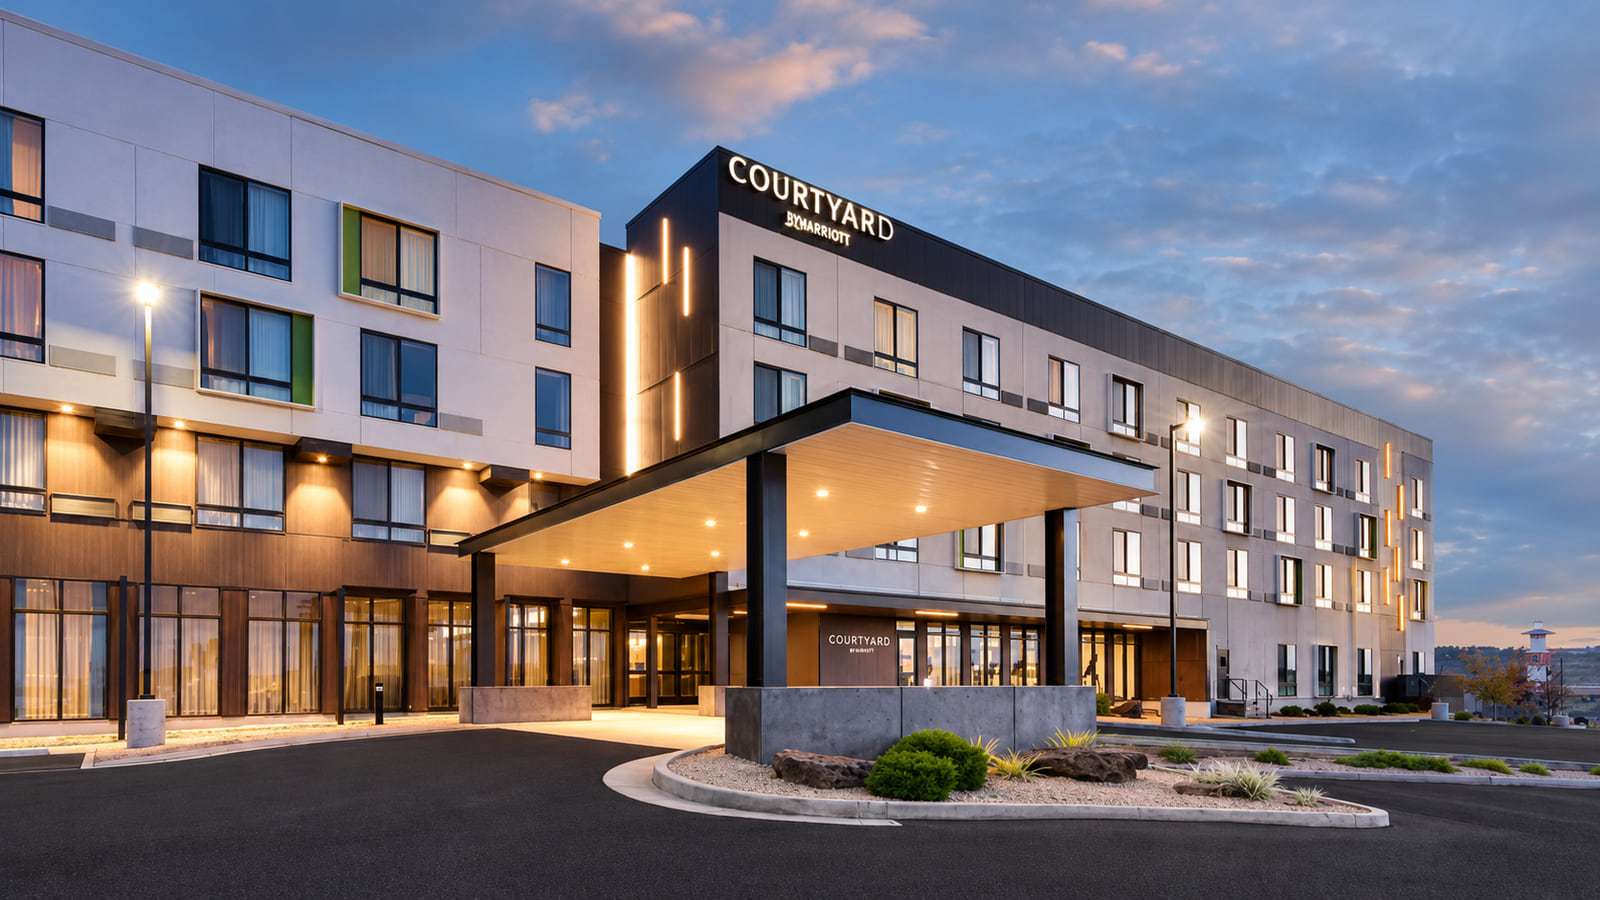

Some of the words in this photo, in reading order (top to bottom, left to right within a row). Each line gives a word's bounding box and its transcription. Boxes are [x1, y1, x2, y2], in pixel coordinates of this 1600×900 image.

[728, 156, 894, 241] COURTYARD
[785, 210, 801, 228] BY
[828, 634, 890, 646] COURTYARD
